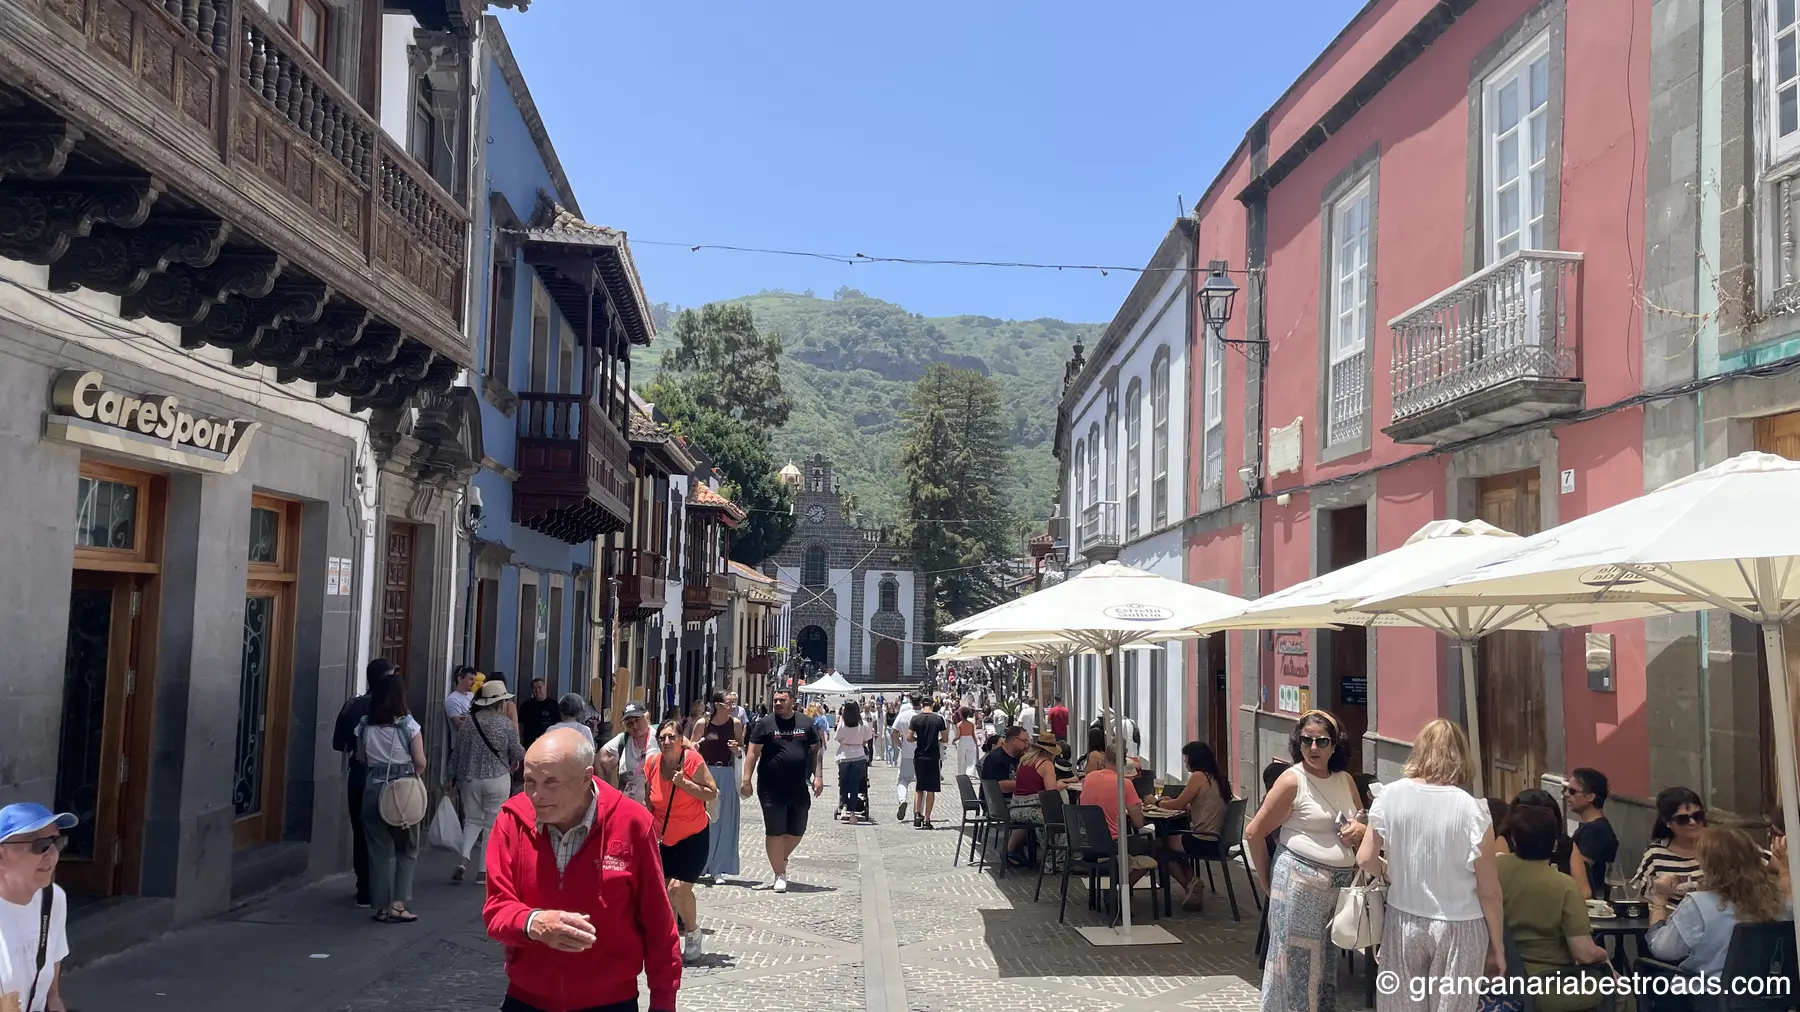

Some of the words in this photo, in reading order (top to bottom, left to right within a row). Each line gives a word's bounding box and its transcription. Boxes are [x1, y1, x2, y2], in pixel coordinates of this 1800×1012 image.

[72, 371, 236, 453] CareSport
[1564, 471, 1571, 484] 7
[1301, 693, 1307, 710] R
